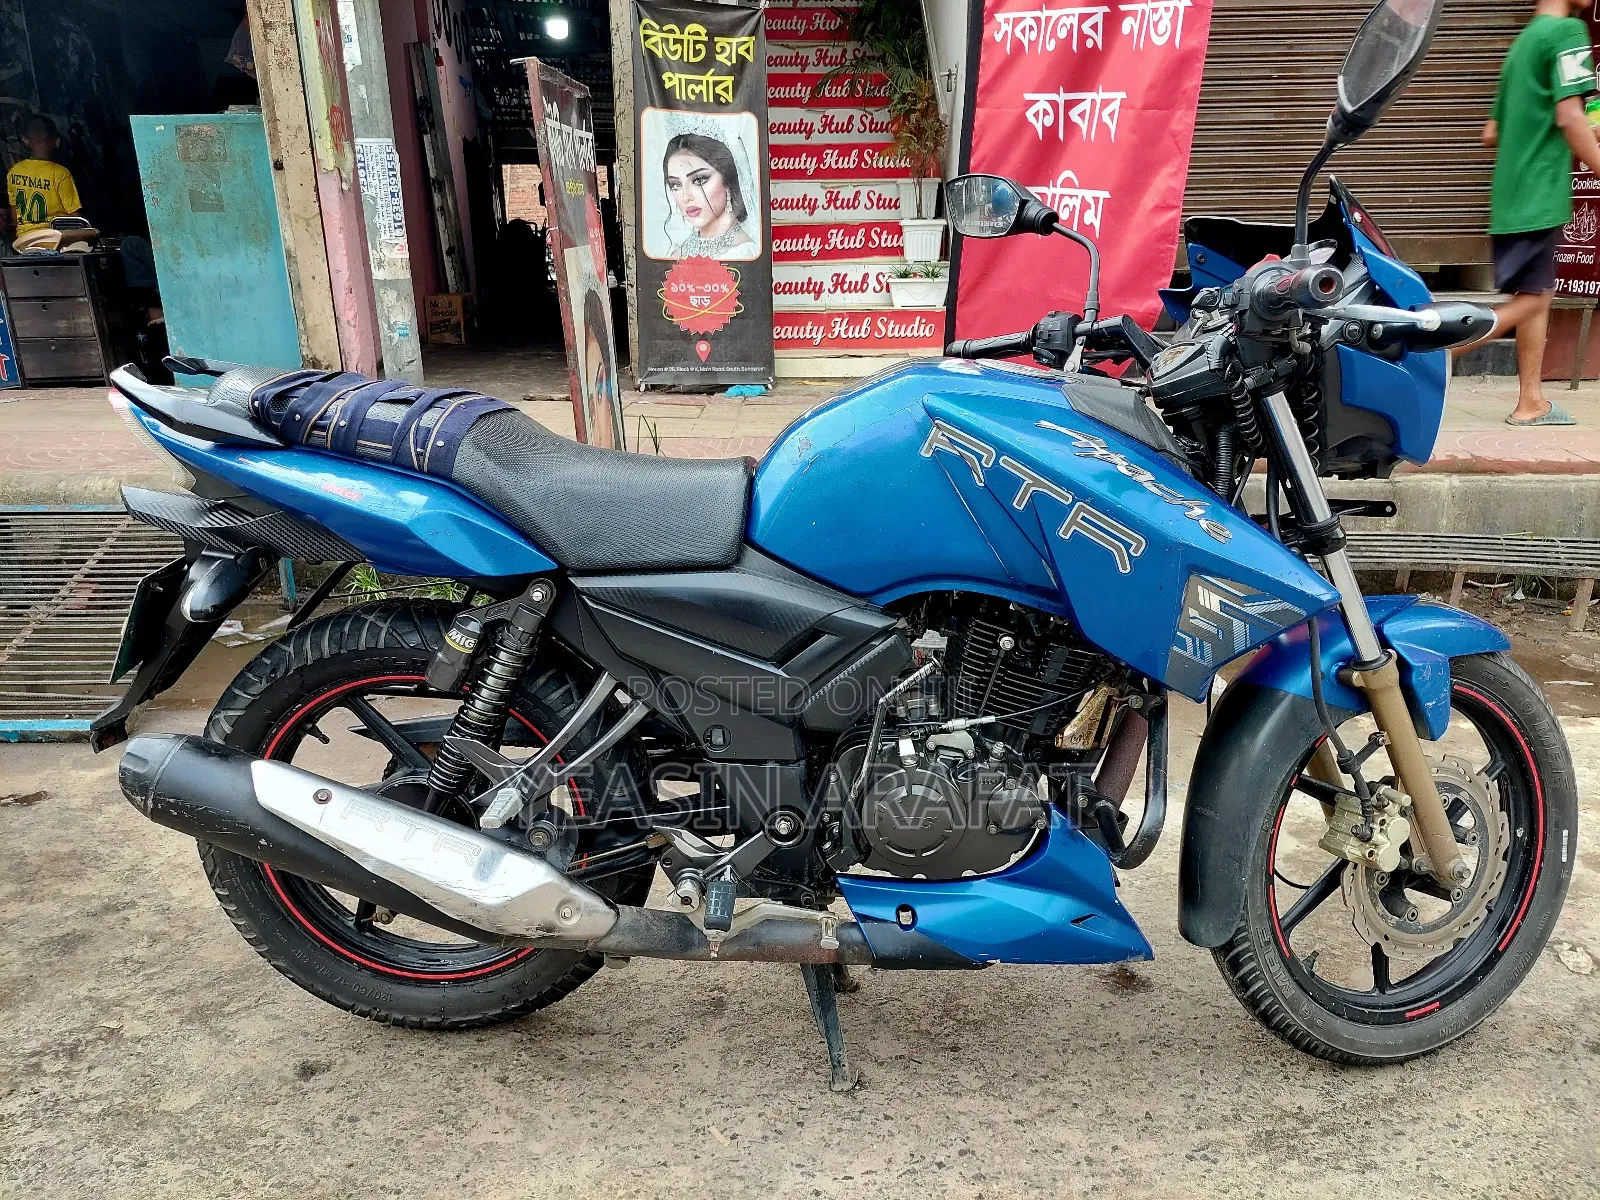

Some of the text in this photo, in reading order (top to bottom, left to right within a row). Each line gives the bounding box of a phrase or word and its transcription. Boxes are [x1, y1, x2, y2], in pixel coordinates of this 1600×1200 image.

[766, 15, 808, 36] eauty
[993, 0, 1193, 55] সকালের নাস্তা
[639, 18, 755, 67] বিউটি হাব
[767, 51, 809, 72] eauty
[812, 48, 848, 67] Hub
[661, 68, 734, 103] পার্লার
[767, 82, 811, 104] eauty
[769, 118, 815, 140] eauty
[818, 113, 854, 134] Hub
[1023, 84, 1128, 143] কাবাব
[769, 152, 818, 175] eauty
[820, 149, 858, 169] Hub
[11, 174, 51, 191] NEYMAR
[1571, 177, 1600, 191] Cookies
[770, 194, 819, 216] eauty
[822, 188, 861, 210] Hub
[1027, 169, 1111, 240] ালিম
[772, 227, 904, 257] eauty Hub Stu
[774, 276, 825, 301] eauty
[828, 272, 869, 294] Hub
[430, 309, 458, 319] Special
[774, 316, 935, 345] eauty Hub Studio
[919, 418, 1148, 575] RTR
